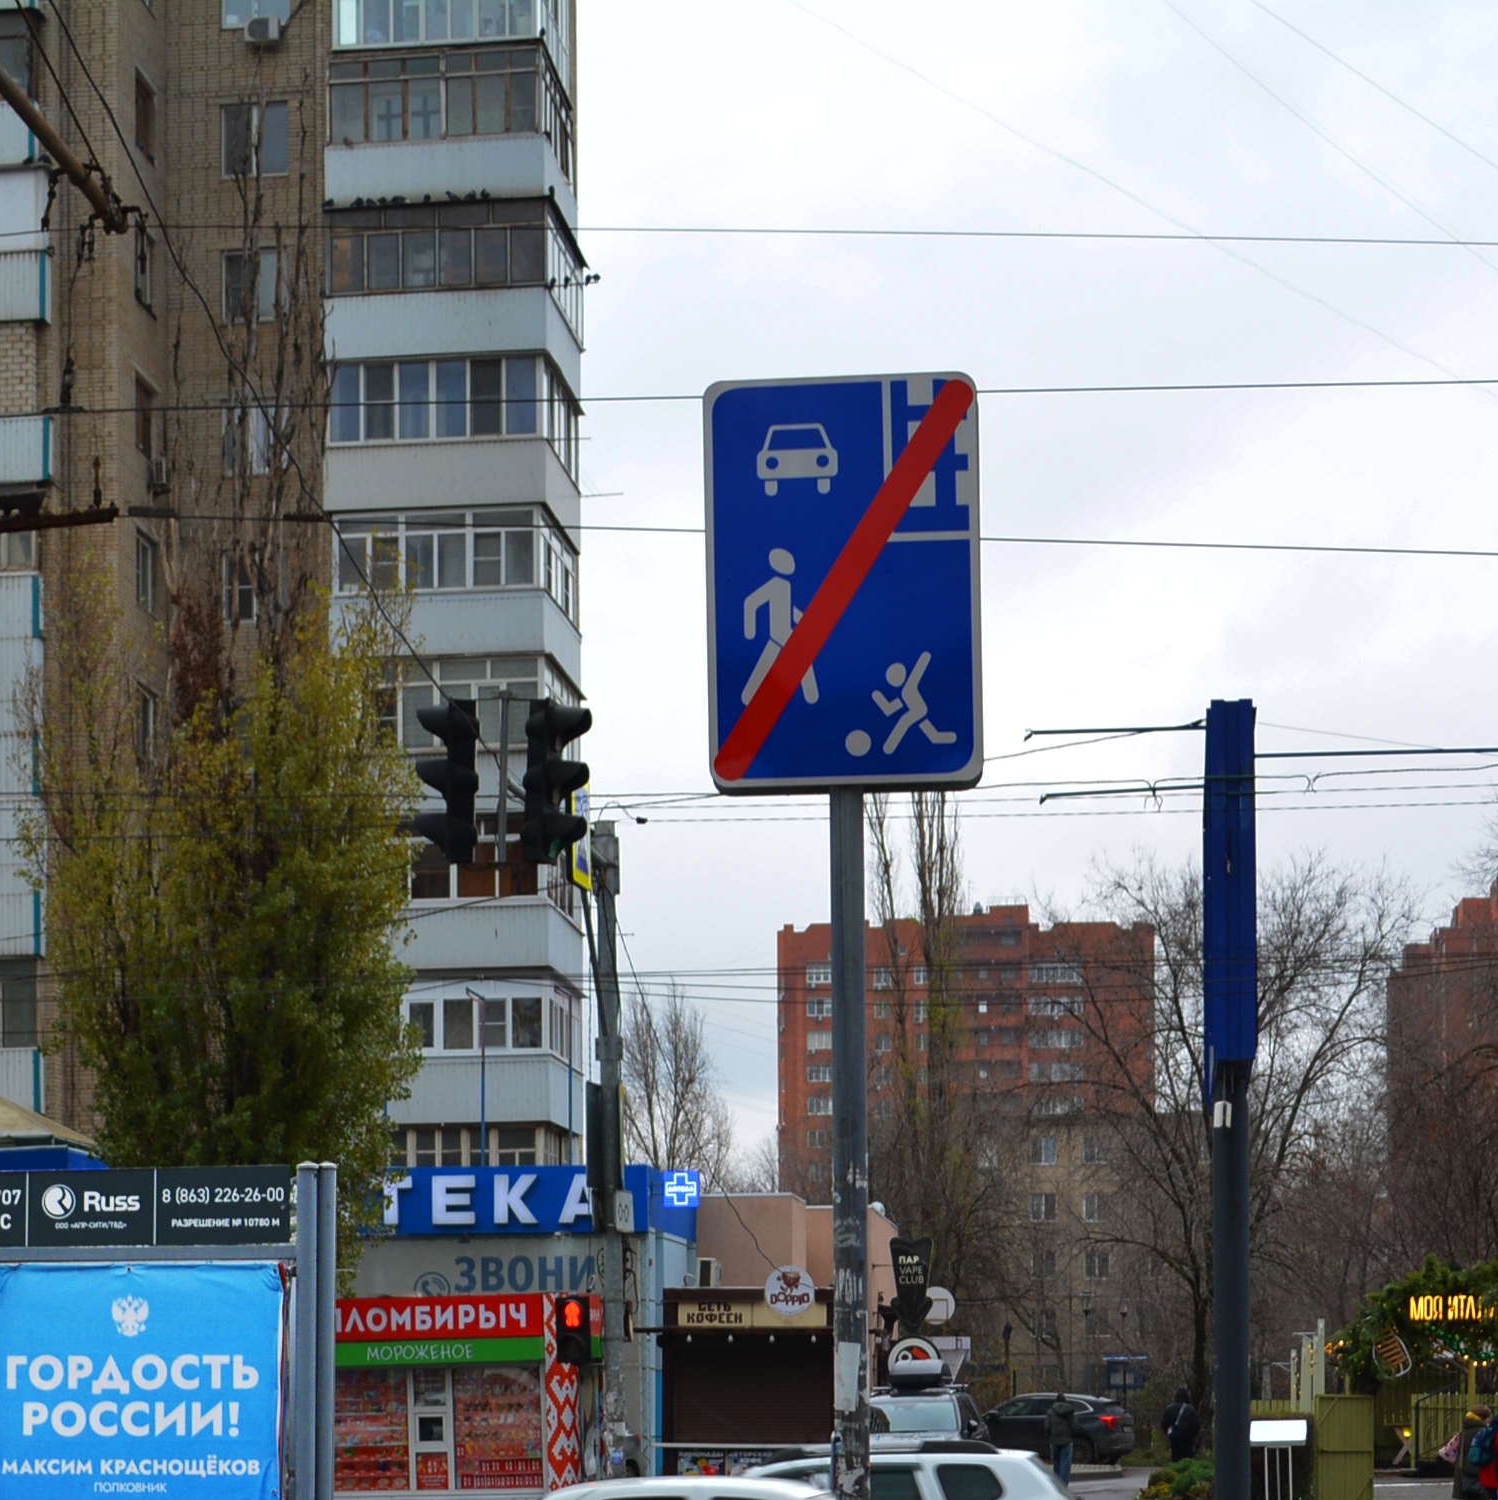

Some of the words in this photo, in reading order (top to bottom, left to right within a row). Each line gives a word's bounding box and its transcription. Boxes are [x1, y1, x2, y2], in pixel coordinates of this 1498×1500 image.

[83, 1190, 141, 1213] Russ
[161, 1188, 171, 1204] 8
[175, 1185, 210, 1206] (863)
[214, 1186, 285, 1203] 226-26-00
[381, 1173, 593, 1226] ТЕКА
[171, 1217, 230, 1228] РАЗРЕШЕНИЕ
[231, 1216, 242, 1228] №
[243, 1217, 270, 1227] 10780
[899, 1255, 919, 1265] ПАР
[899, 1266, 923, 1275] VAPE
[899, 1275, 924, 1284] CLUB
[698, 1302, 731, 1311] СЕТЬ
[770, 1292, 810, 1306] DOPPIO
[1410, 1295, 1443, 1320] МОЯ
[687, 1313, 743, 1323] КОФЕЕН
[367, 1344, 474, 1361] МОРОЖЕНОЕ
[6, 1354, 259, 1394] ГОРДОСТЬ
[23, 1401, 240, 1437] РОССИИ!
[2, 1459, 93, 1475] МАКСИМ
[101, 1454, 260, 1478] КРАСНОЩЁКОВ
[94, 1482, 167, 1493] ПОЛКОВНИК
